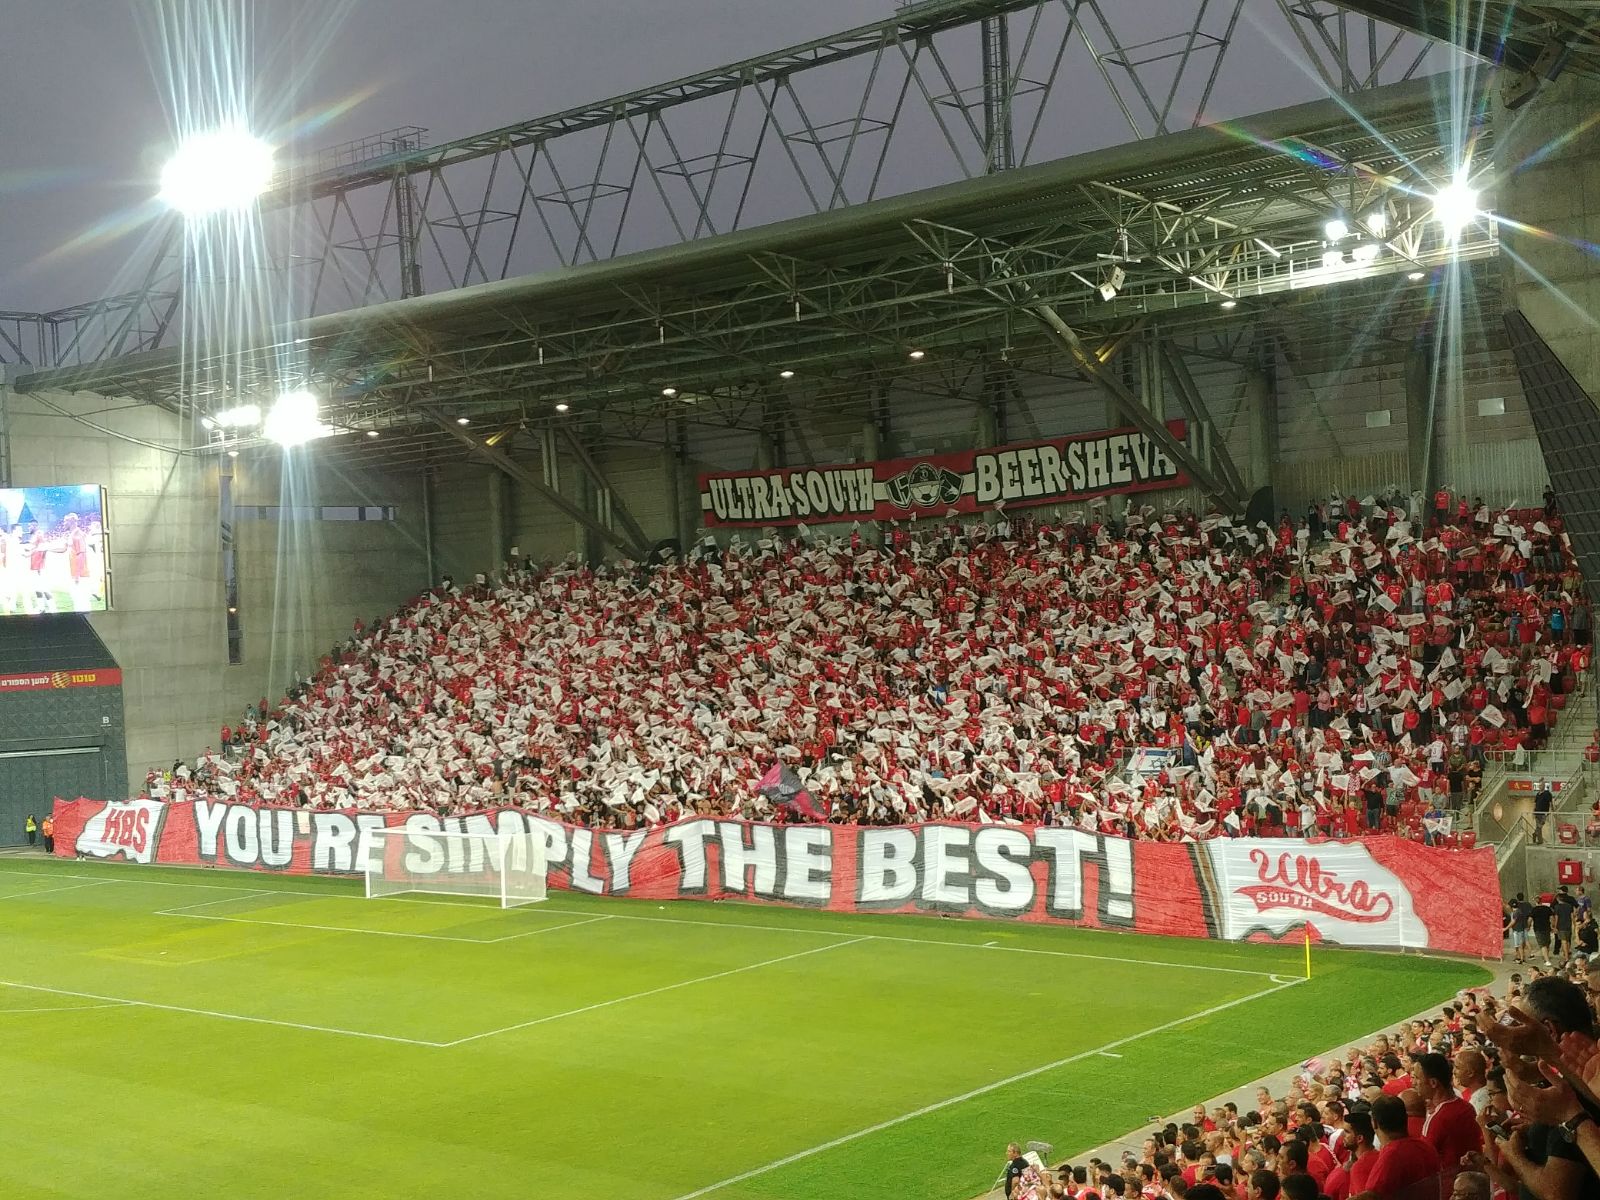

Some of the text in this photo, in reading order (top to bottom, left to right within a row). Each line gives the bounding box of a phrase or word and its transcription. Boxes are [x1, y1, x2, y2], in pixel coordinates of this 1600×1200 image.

[101, 807, 149, 854] HBS
[195, 800, 1134, 919] YOU'RE SIMPLY THE BEST!
[1248, 848, 1393, 914] Ultra
[1256, 891, 1313, 908] SOUTH
